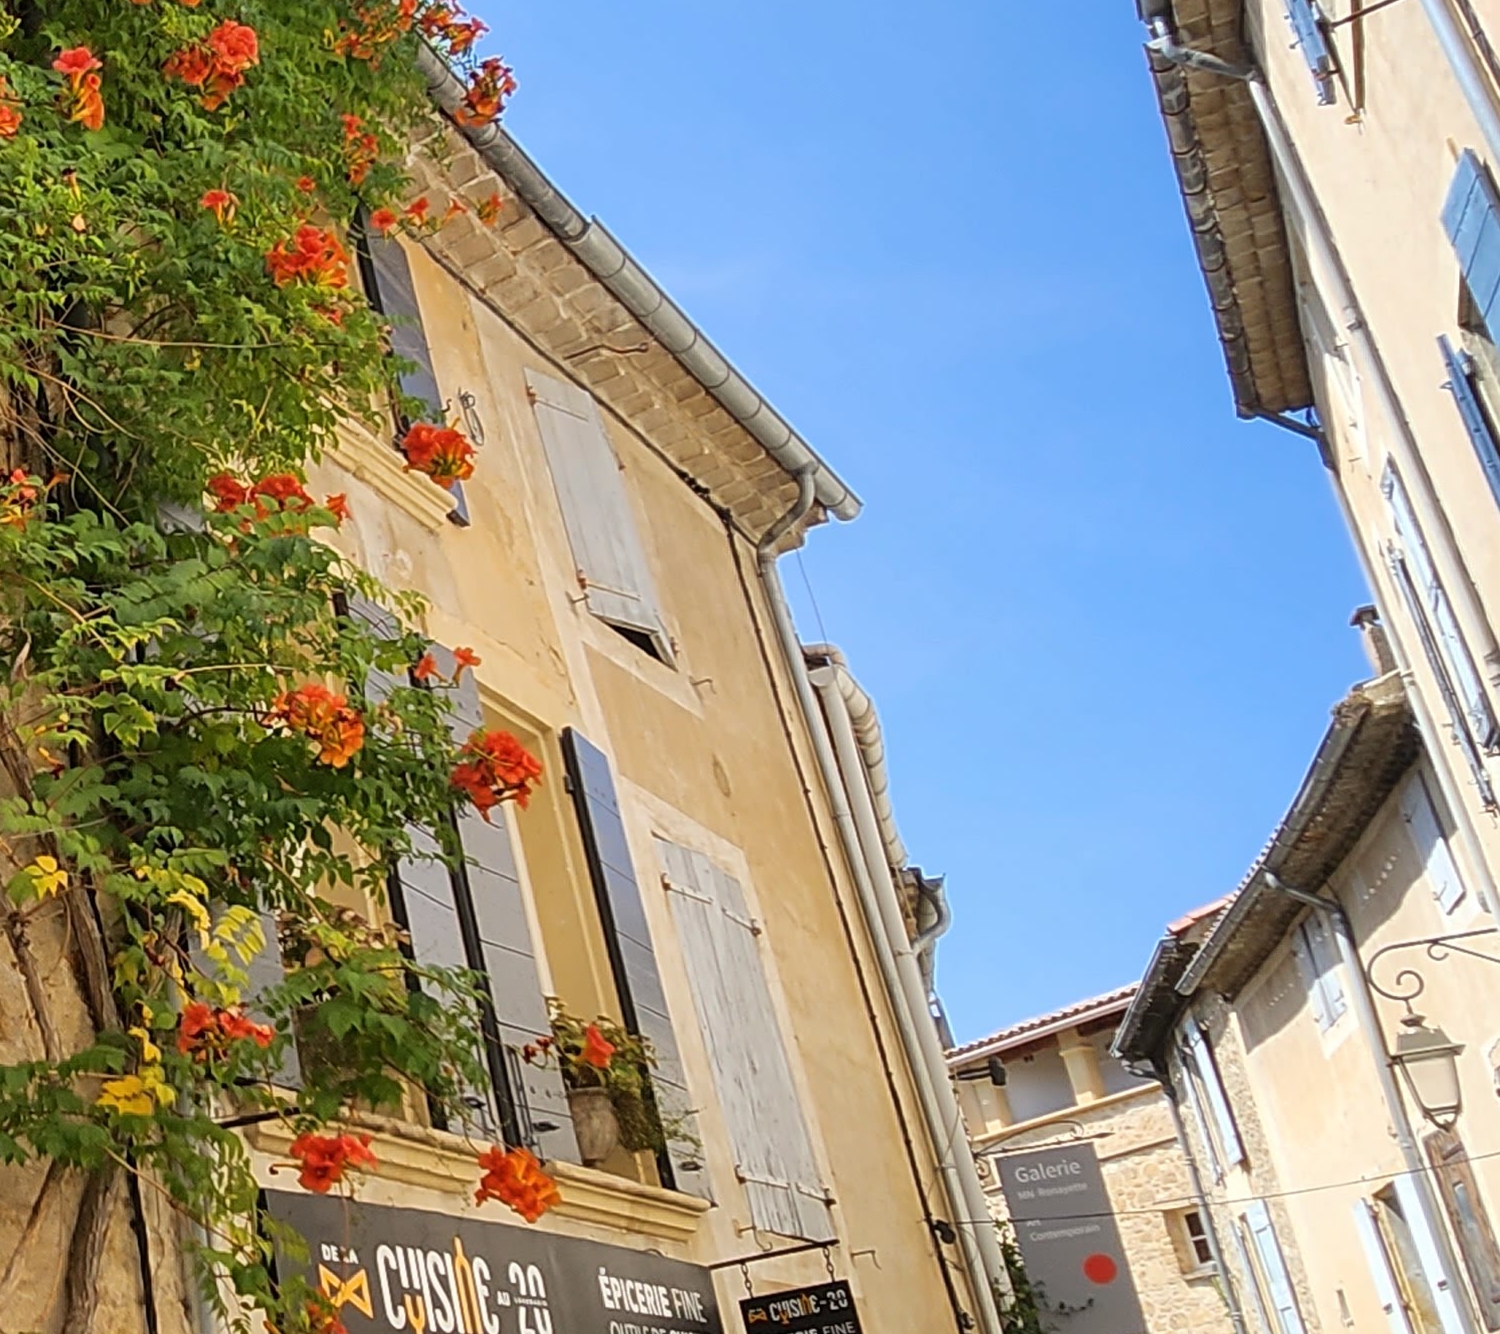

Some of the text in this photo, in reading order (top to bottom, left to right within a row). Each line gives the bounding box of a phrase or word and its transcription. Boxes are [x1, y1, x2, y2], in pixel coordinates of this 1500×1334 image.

[1015, 1158, 1081, 1183] Galerie
[1030, 1224, 1101, 1242] Contemporain
[321, 1243, 339, 1262] DE
[598, 1266, 708, 1323] ÉPICERIE FINE
[826, 1289, 848, 1310] 20
